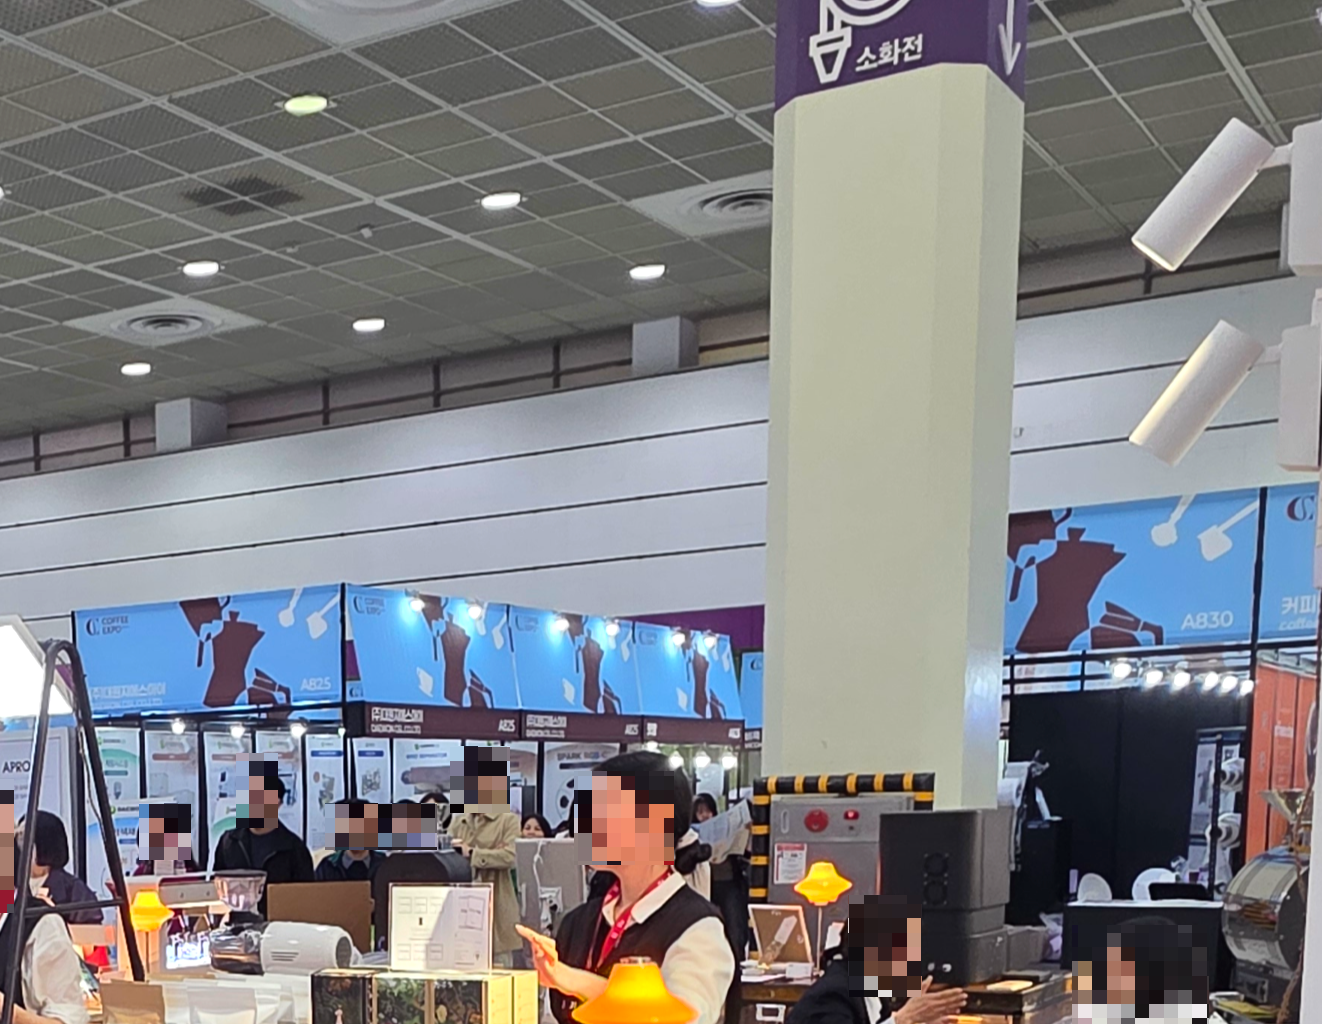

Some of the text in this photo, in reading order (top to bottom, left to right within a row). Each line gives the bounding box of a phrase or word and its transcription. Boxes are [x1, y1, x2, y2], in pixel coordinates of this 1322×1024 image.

[855, 33, 924, 72] 소화전
[101, 615, 129, 626] COFFEE
[1181, 610, 1234, 631] A830
[102, 625, 122, 635] EXPO
